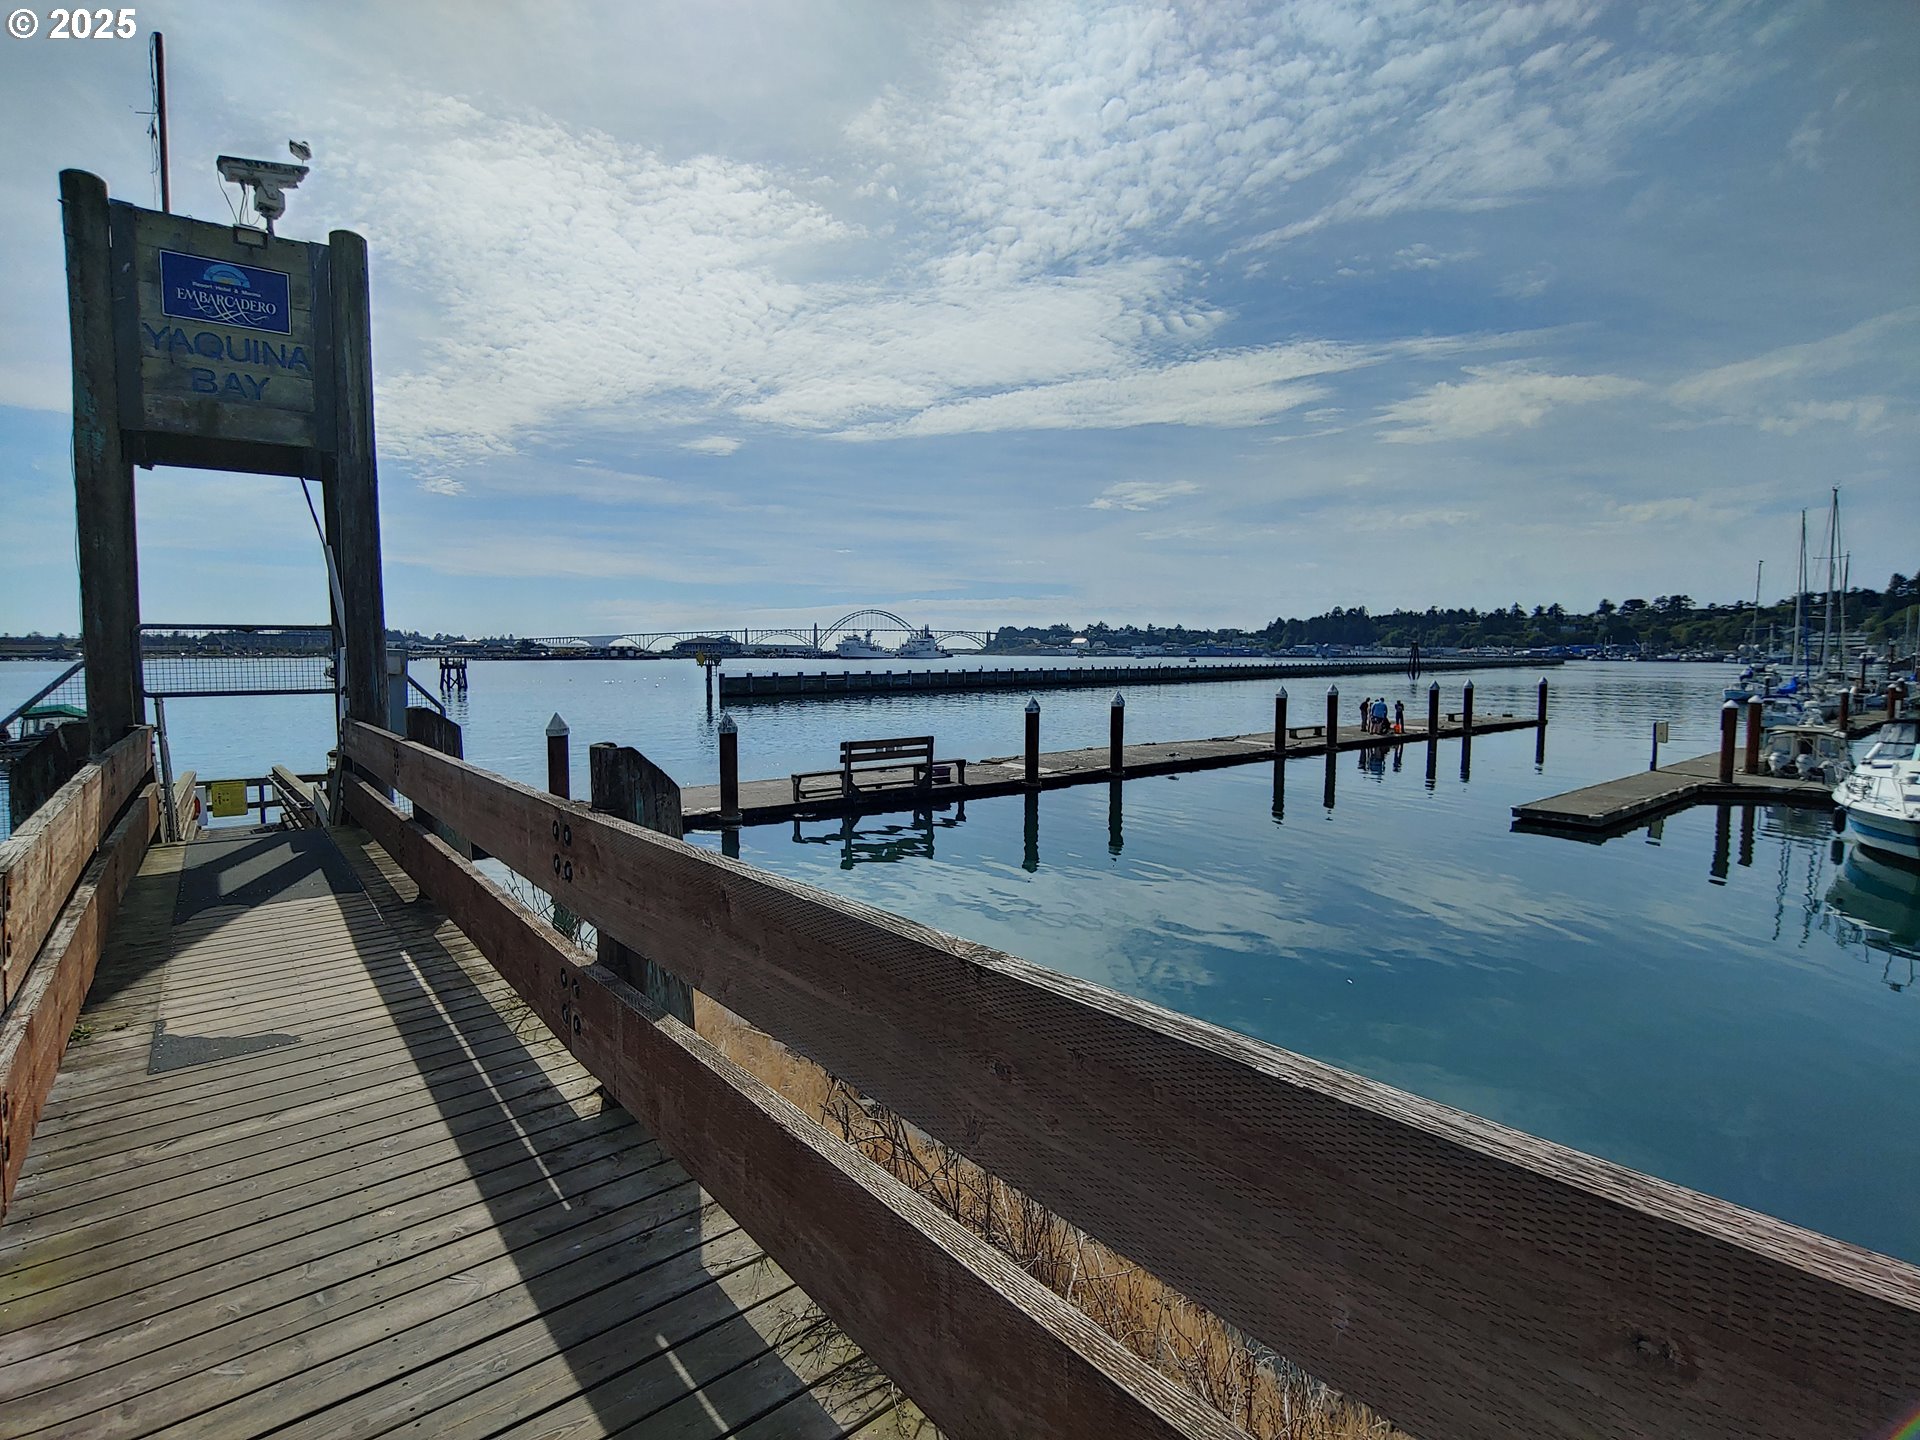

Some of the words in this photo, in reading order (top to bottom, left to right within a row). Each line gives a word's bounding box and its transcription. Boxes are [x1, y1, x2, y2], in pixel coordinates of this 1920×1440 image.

[176, 286, 277, 317] EMBARCADERO
[141, 322, 312, 372] YAQUINA
[192, 366, 270, 400] BAY
